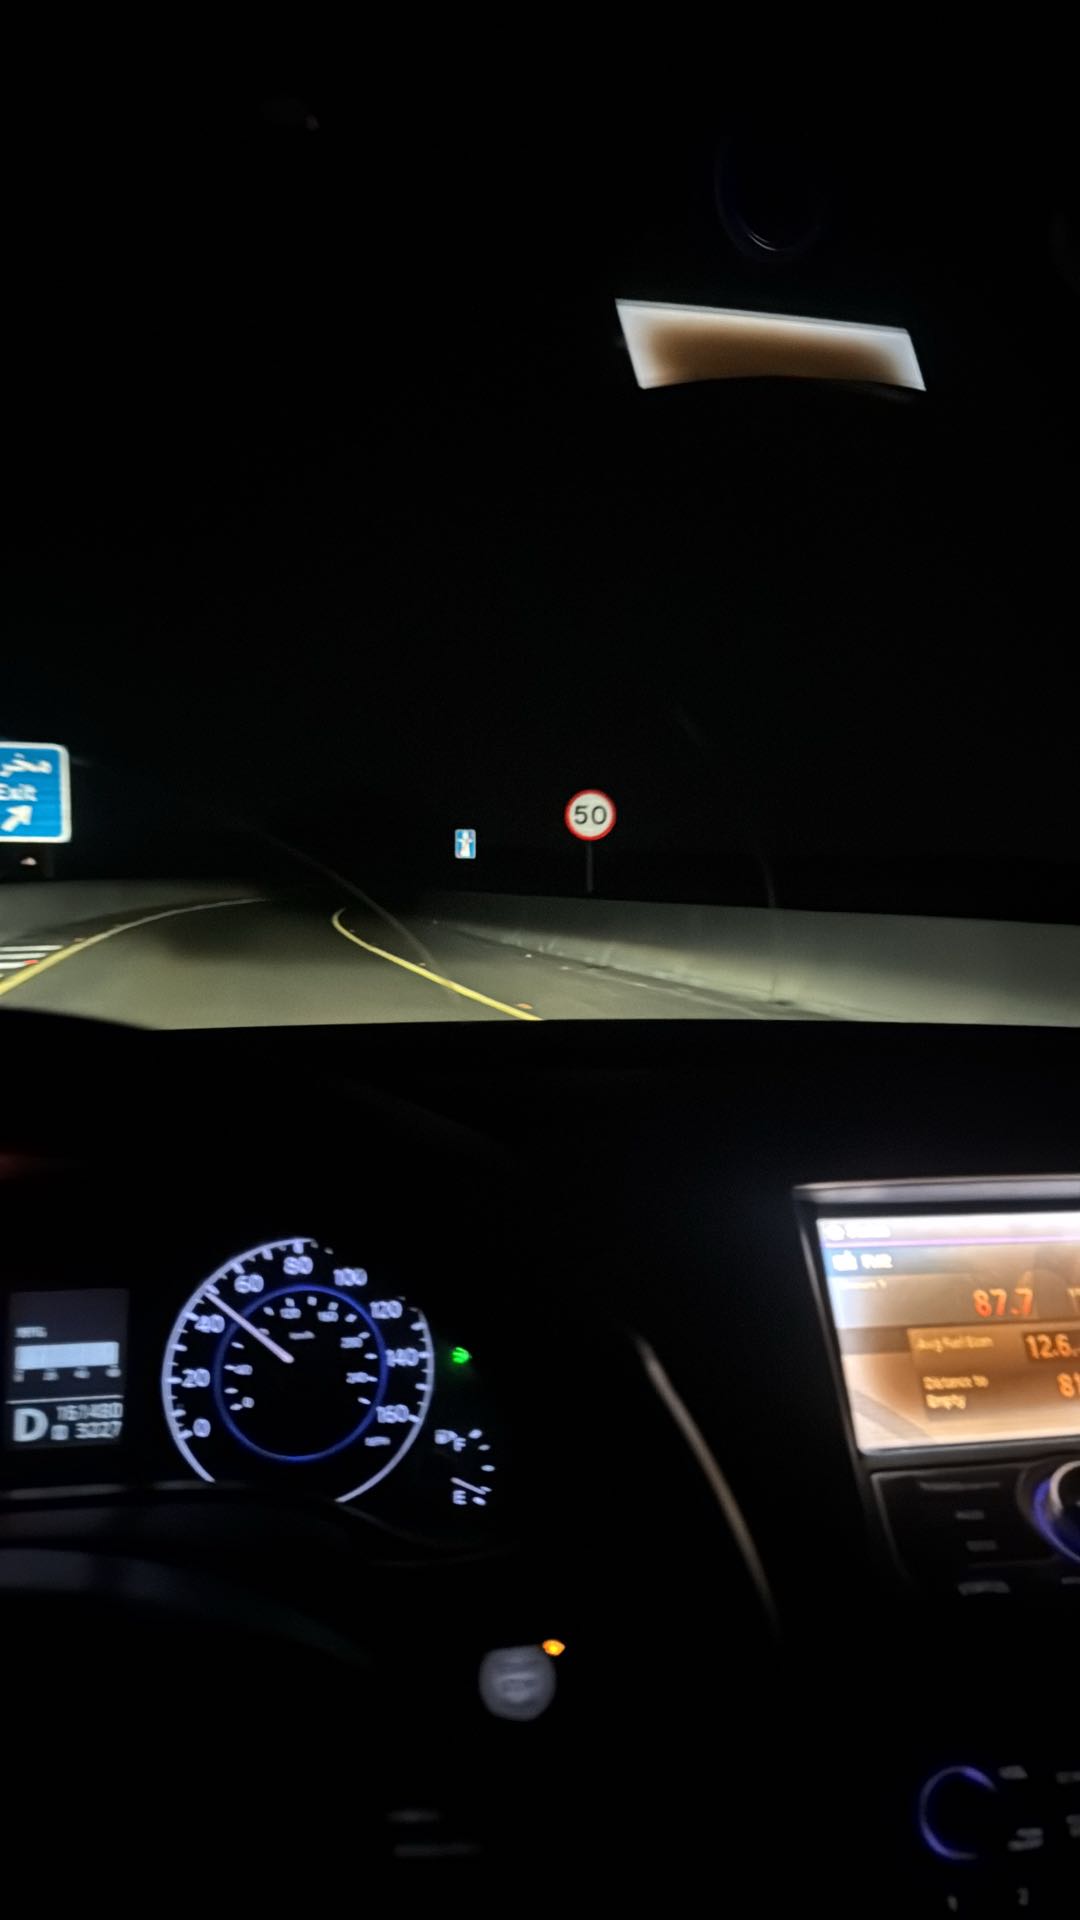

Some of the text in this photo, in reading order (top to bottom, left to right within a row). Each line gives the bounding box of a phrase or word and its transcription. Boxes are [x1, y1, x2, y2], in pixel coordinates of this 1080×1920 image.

[574, 805, 607, 825] 50
[283, 1256, 313, 1275] 80
[234, 1274, 264, 1293] 60
[333, 1267, 368, 1287] 100
[370, 1300, 403, 1319] 120
[973, 1287, 1033, 1318] 87.7
[194, 1314, 226, 1334] 40
[386, 1347, 420, 1367] 140
[181, 1367, 211, 1388] 20
[376, 1404, 410, 1424] 160
[13, 1408, 48, 1442] D
[193, 1418, 212, 1437] 0
[453, 1437, 466, 1452] F
[452, 1490, 467, 1505] E
